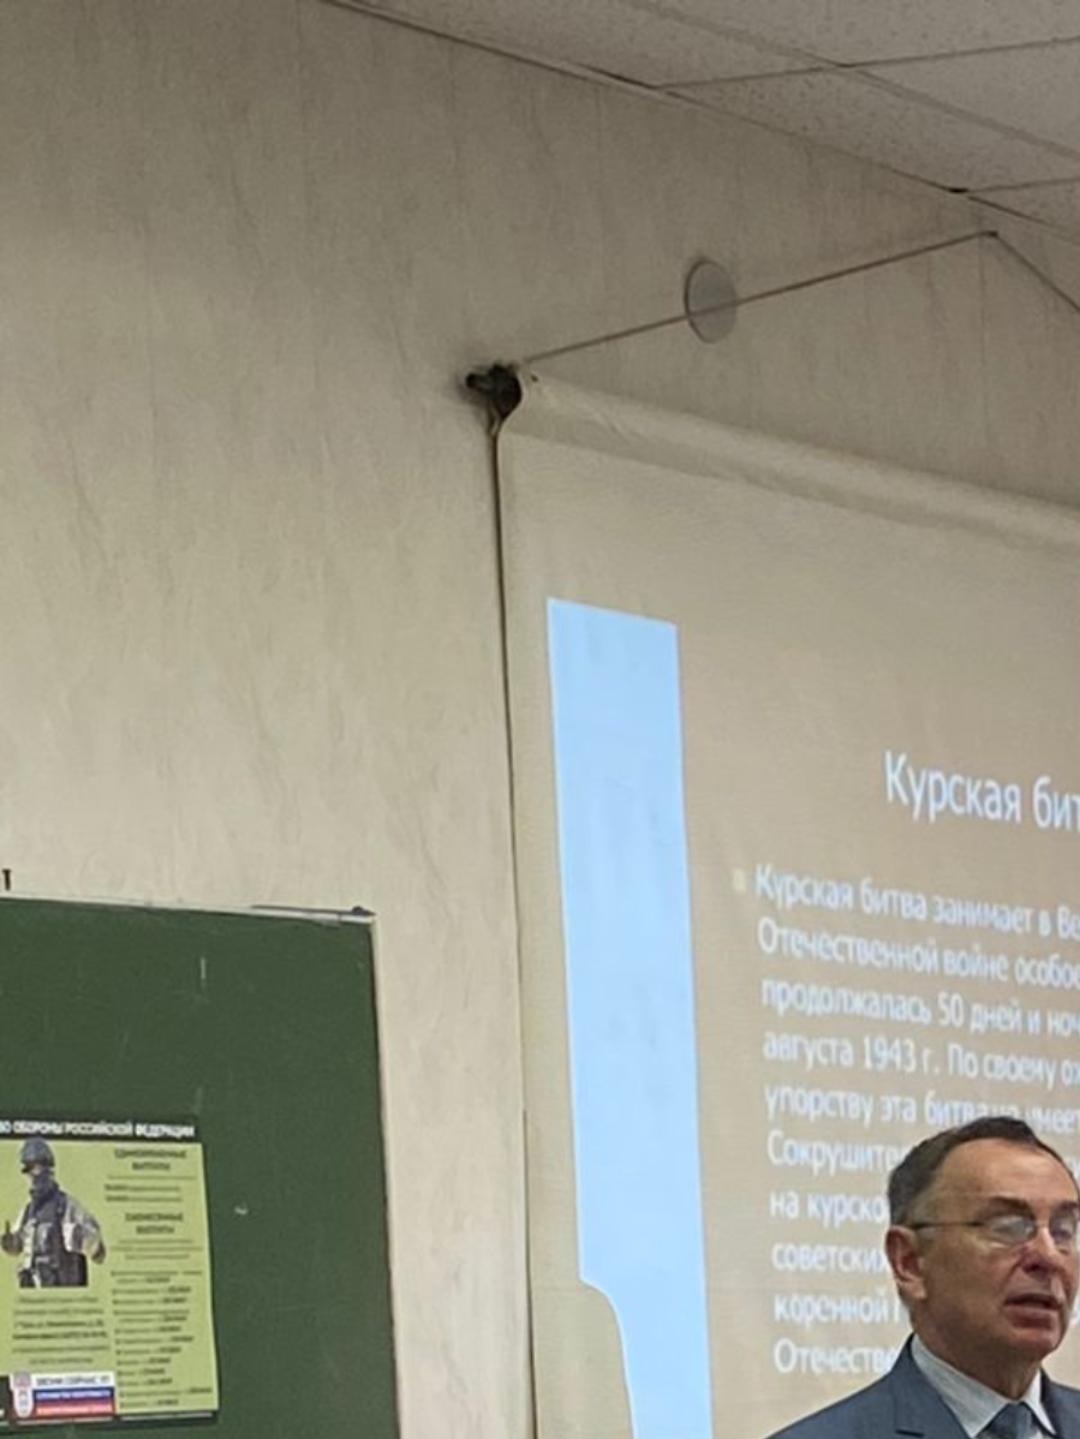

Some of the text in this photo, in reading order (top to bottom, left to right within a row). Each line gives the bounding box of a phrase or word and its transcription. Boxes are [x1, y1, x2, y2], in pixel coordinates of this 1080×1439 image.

[883, 750, 1022, 825] Курская
[755, 862, 853, 911] Курская
[860, 876, 928, 922] битва
[932, 895, 1036, 934] занимает
[1037, 910, 1051, 938] в
[757, 915, 939, 974] Отечественной
[943, 942, 1009, 982] войне
[761, 978, 932, 1026] продолжалась
[937, 990, 965, 1027] 50
[970, 998, 1023, 1035] дней
[1027, 1008, 1042, 1036] и
[762, 1030, 854, 1071] августа
[863, 1035, 917, 1074] 1943
[921, 1047, 940, 1075] г.
[947, 1042, 979, 1078] По
[983, 1053, 1057, 1091] своему
[764, 1084, 874, 1128] упорству
[879, 1093, 917, 1122] эта
[768, 1190, 800, 1220] на
[773, 1286, 888, 1331] коренной
